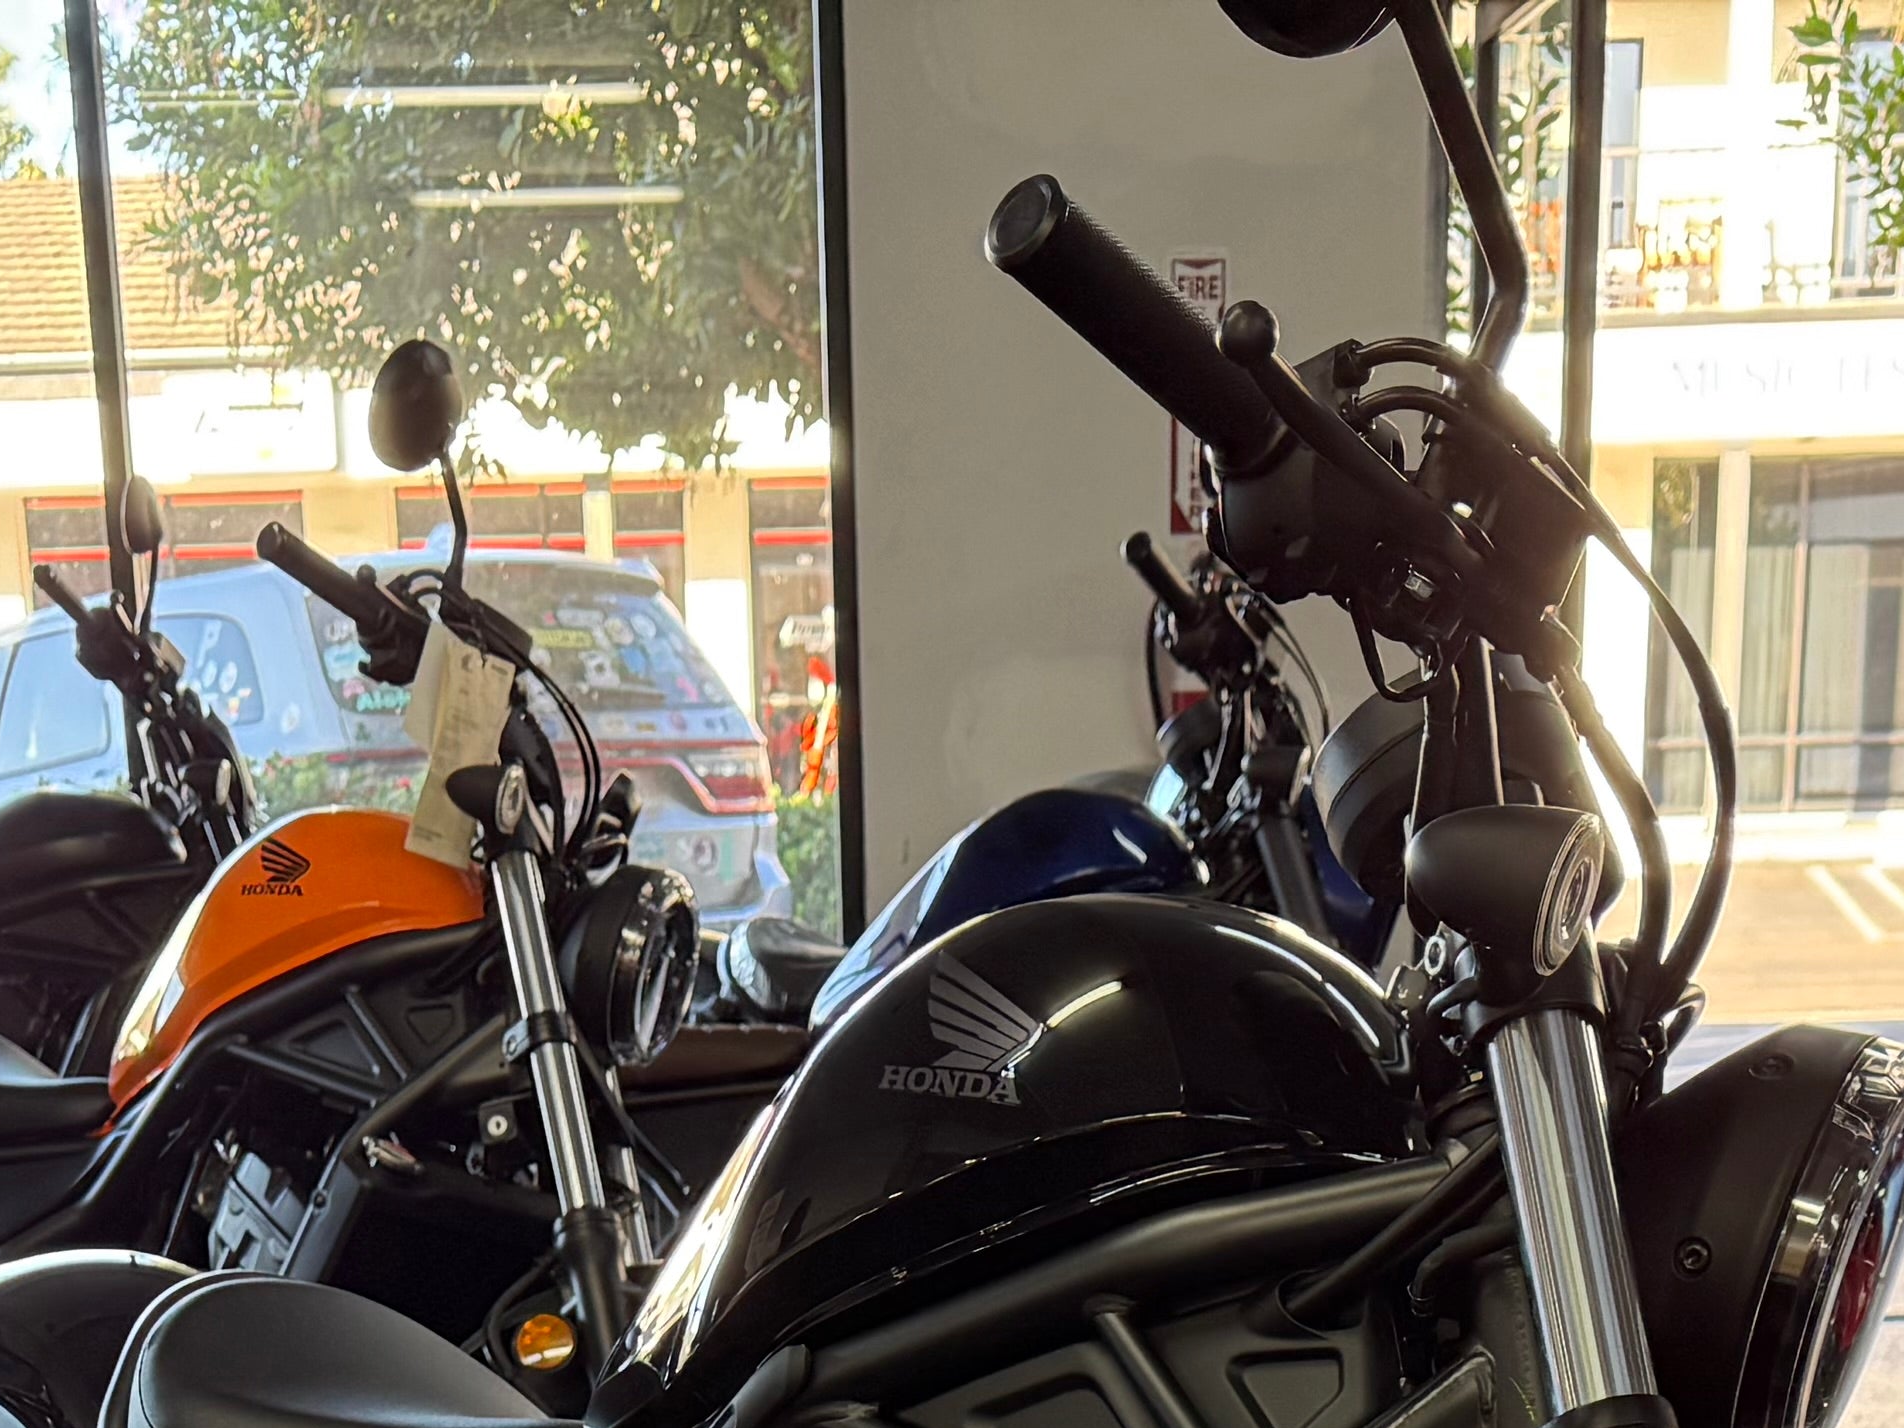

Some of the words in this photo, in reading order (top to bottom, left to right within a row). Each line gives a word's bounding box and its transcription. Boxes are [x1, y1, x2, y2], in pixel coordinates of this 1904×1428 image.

[1177, 275, 1219, 300] FIRE
[241, 884, 304, 897] HONDA
[878, 1065, 1022, 1106] HONDA
